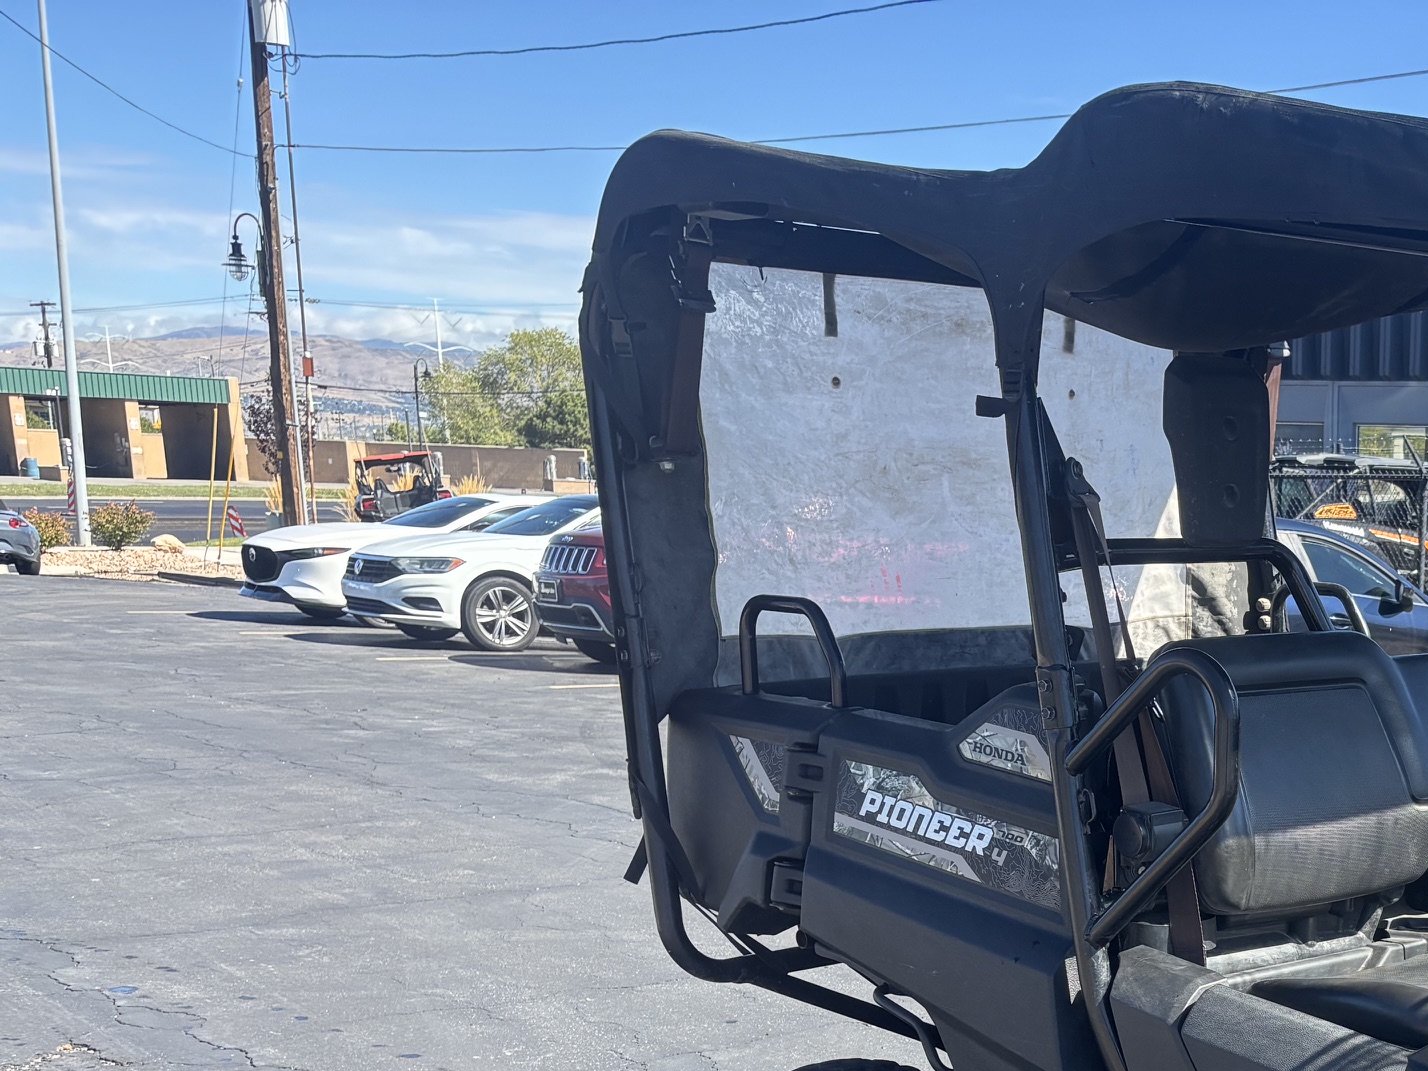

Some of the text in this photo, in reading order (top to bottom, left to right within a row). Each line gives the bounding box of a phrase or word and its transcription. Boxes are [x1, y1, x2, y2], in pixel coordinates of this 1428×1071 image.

[972, 741, 1026, 766] HONDA
[859, 790, 993, 856] PIONEER
[999, 830, 1024, 844] 700
